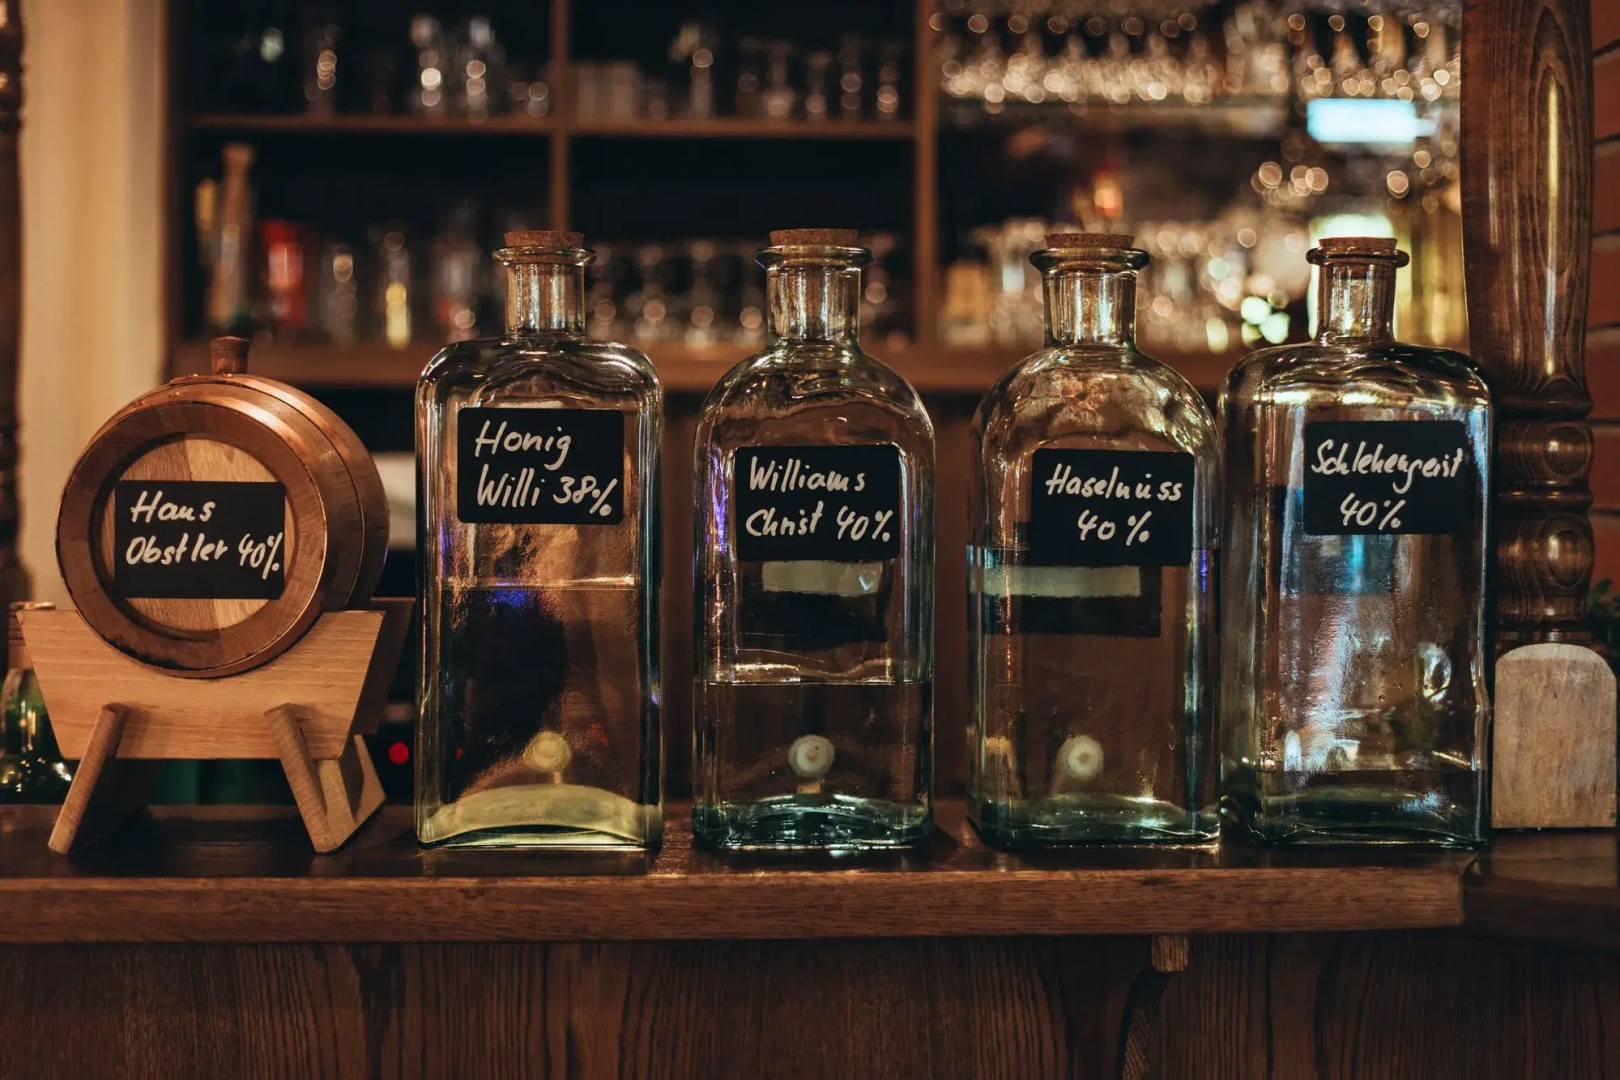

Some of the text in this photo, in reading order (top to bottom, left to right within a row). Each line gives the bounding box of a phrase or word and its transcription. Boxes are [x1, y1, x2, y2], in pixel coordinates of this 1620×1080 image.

[475, 419, 572, 471] Honig
[477, 463, 618, 517] Willi 38%
[749, 455, 866, 493] Williams
[745, 500, 894, 543] Christ 40%
[1340, 492, 1406, 530] 40%
[125, 532, 283, 580] Obstler 40%
